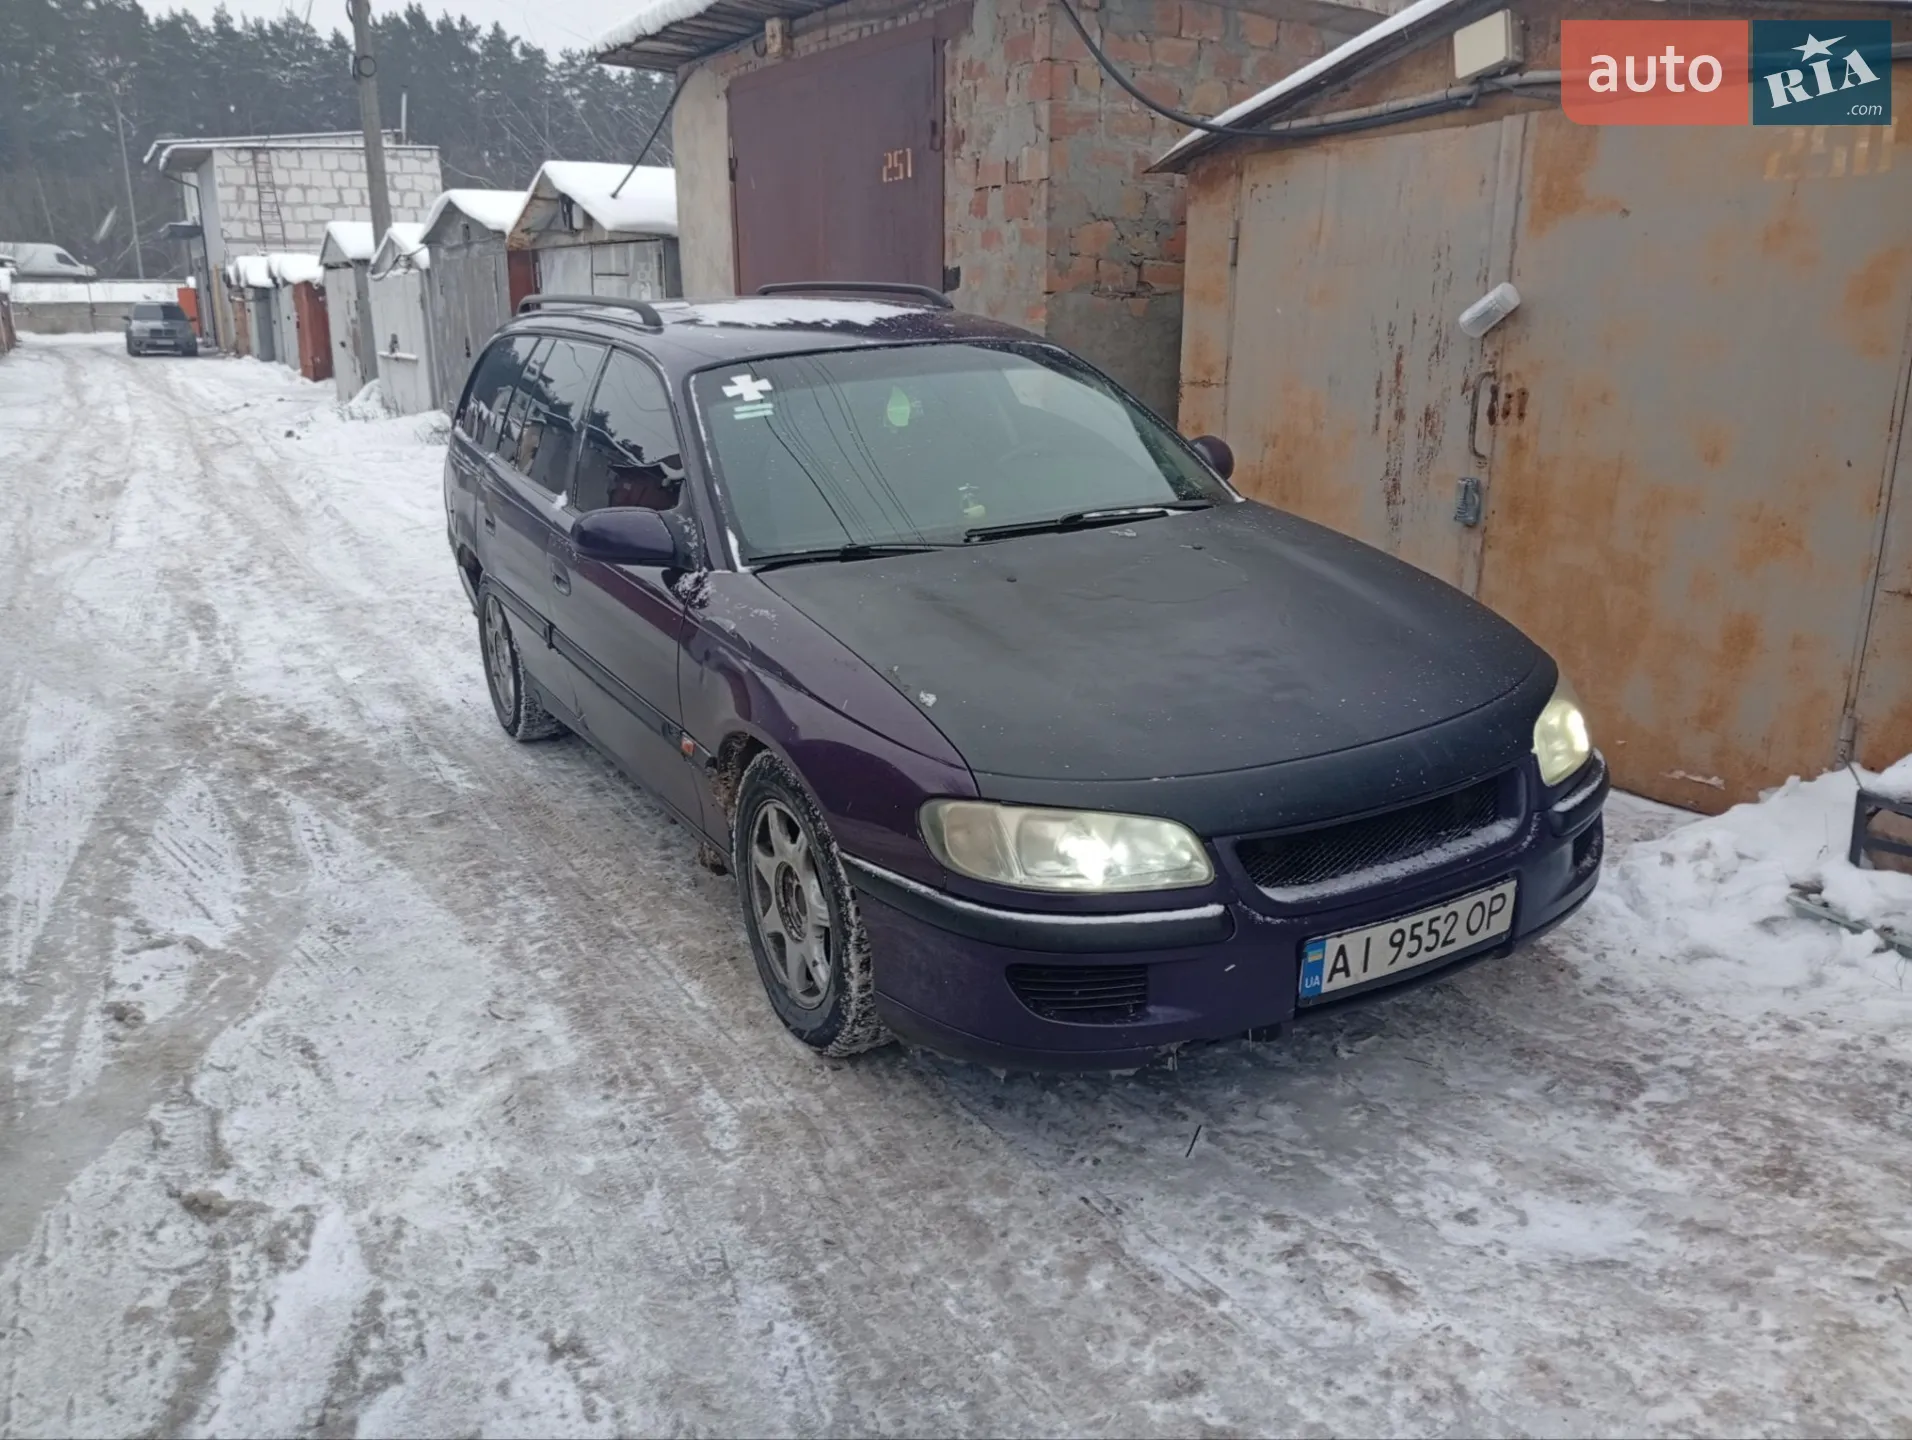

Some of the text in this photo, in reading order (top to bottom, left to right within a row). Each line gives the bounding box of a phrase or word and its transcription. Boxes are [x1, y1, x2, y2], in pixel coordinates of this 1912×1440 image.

[882, 148, 912, 182] 251
[1326, 892, 1507, 983] AI 9552 OP
[1304, 977, 1321, 989] UA
